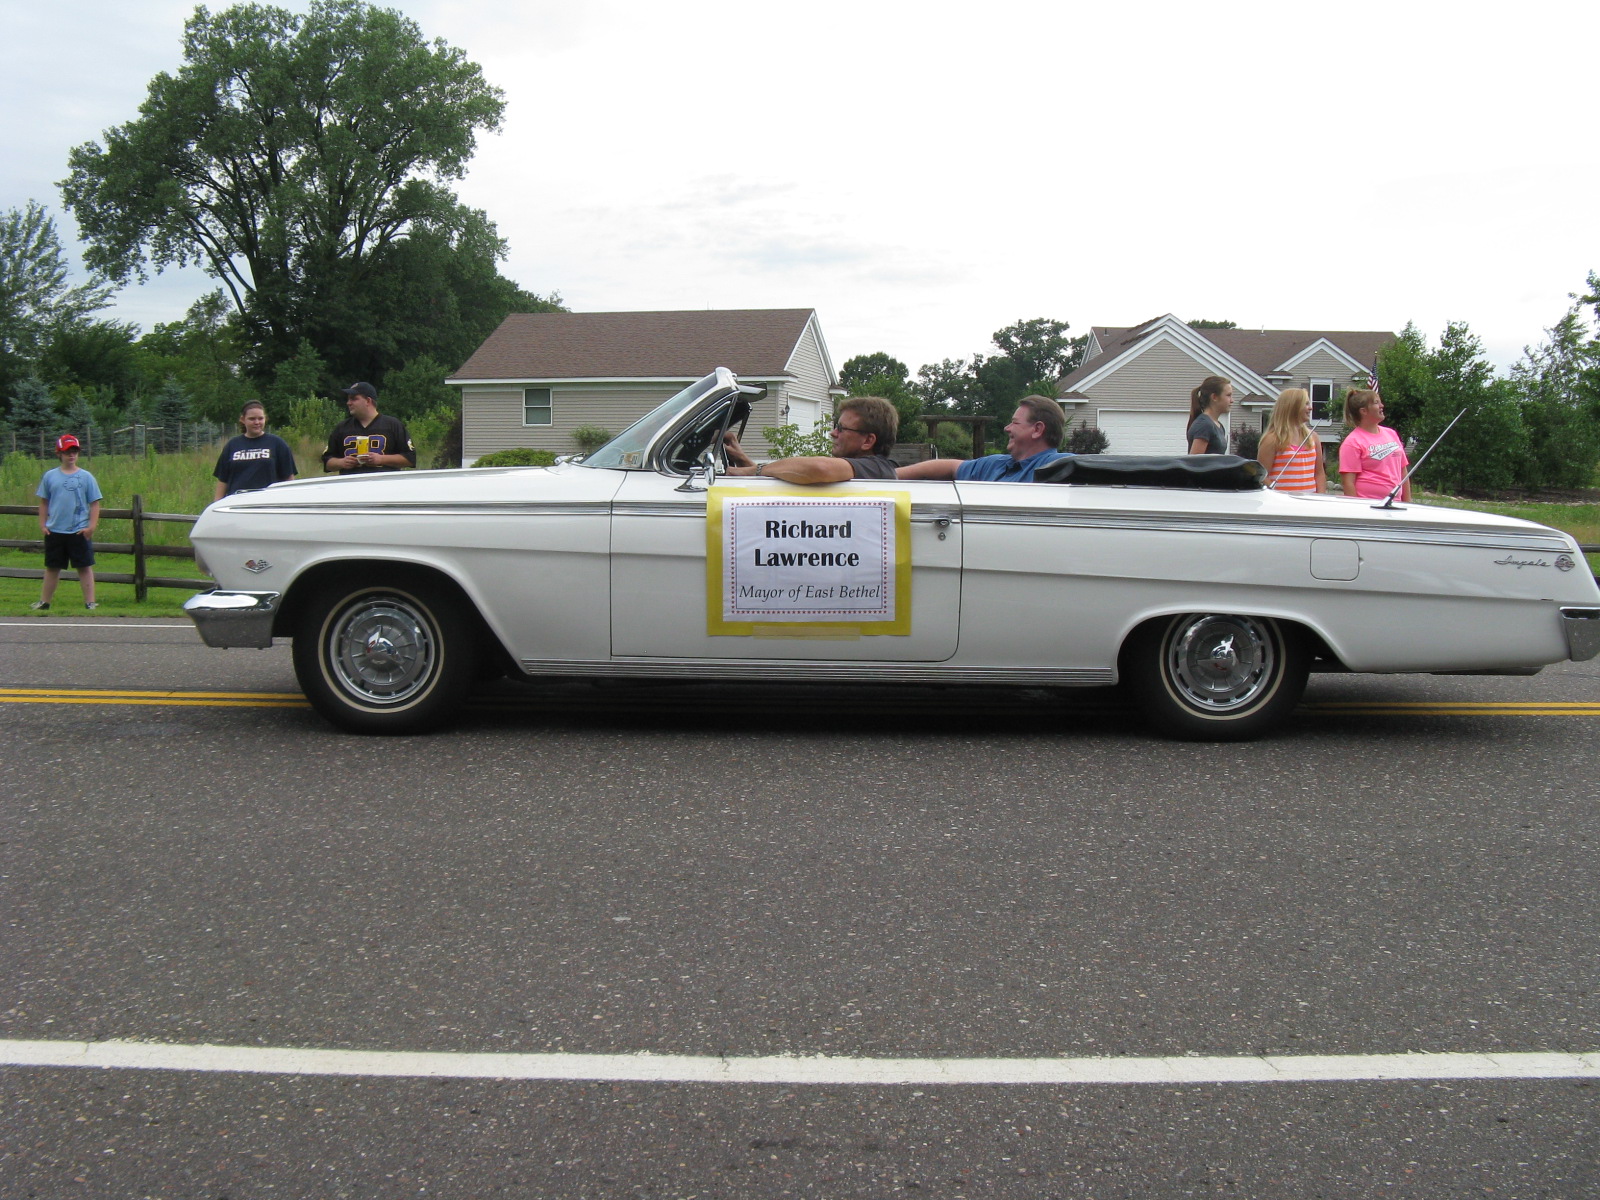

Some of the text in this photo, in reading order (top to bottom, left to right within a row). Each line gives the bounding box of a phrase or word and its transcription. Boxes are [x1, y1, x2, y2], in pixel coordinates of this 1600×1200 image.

[232, 448, 270, 461] SAINTS
[765, 520, 852, 538] Richard
[754, 548, 860, 567] Lawrence
[739, 584, 881, 602] Mayor of East Bethel
